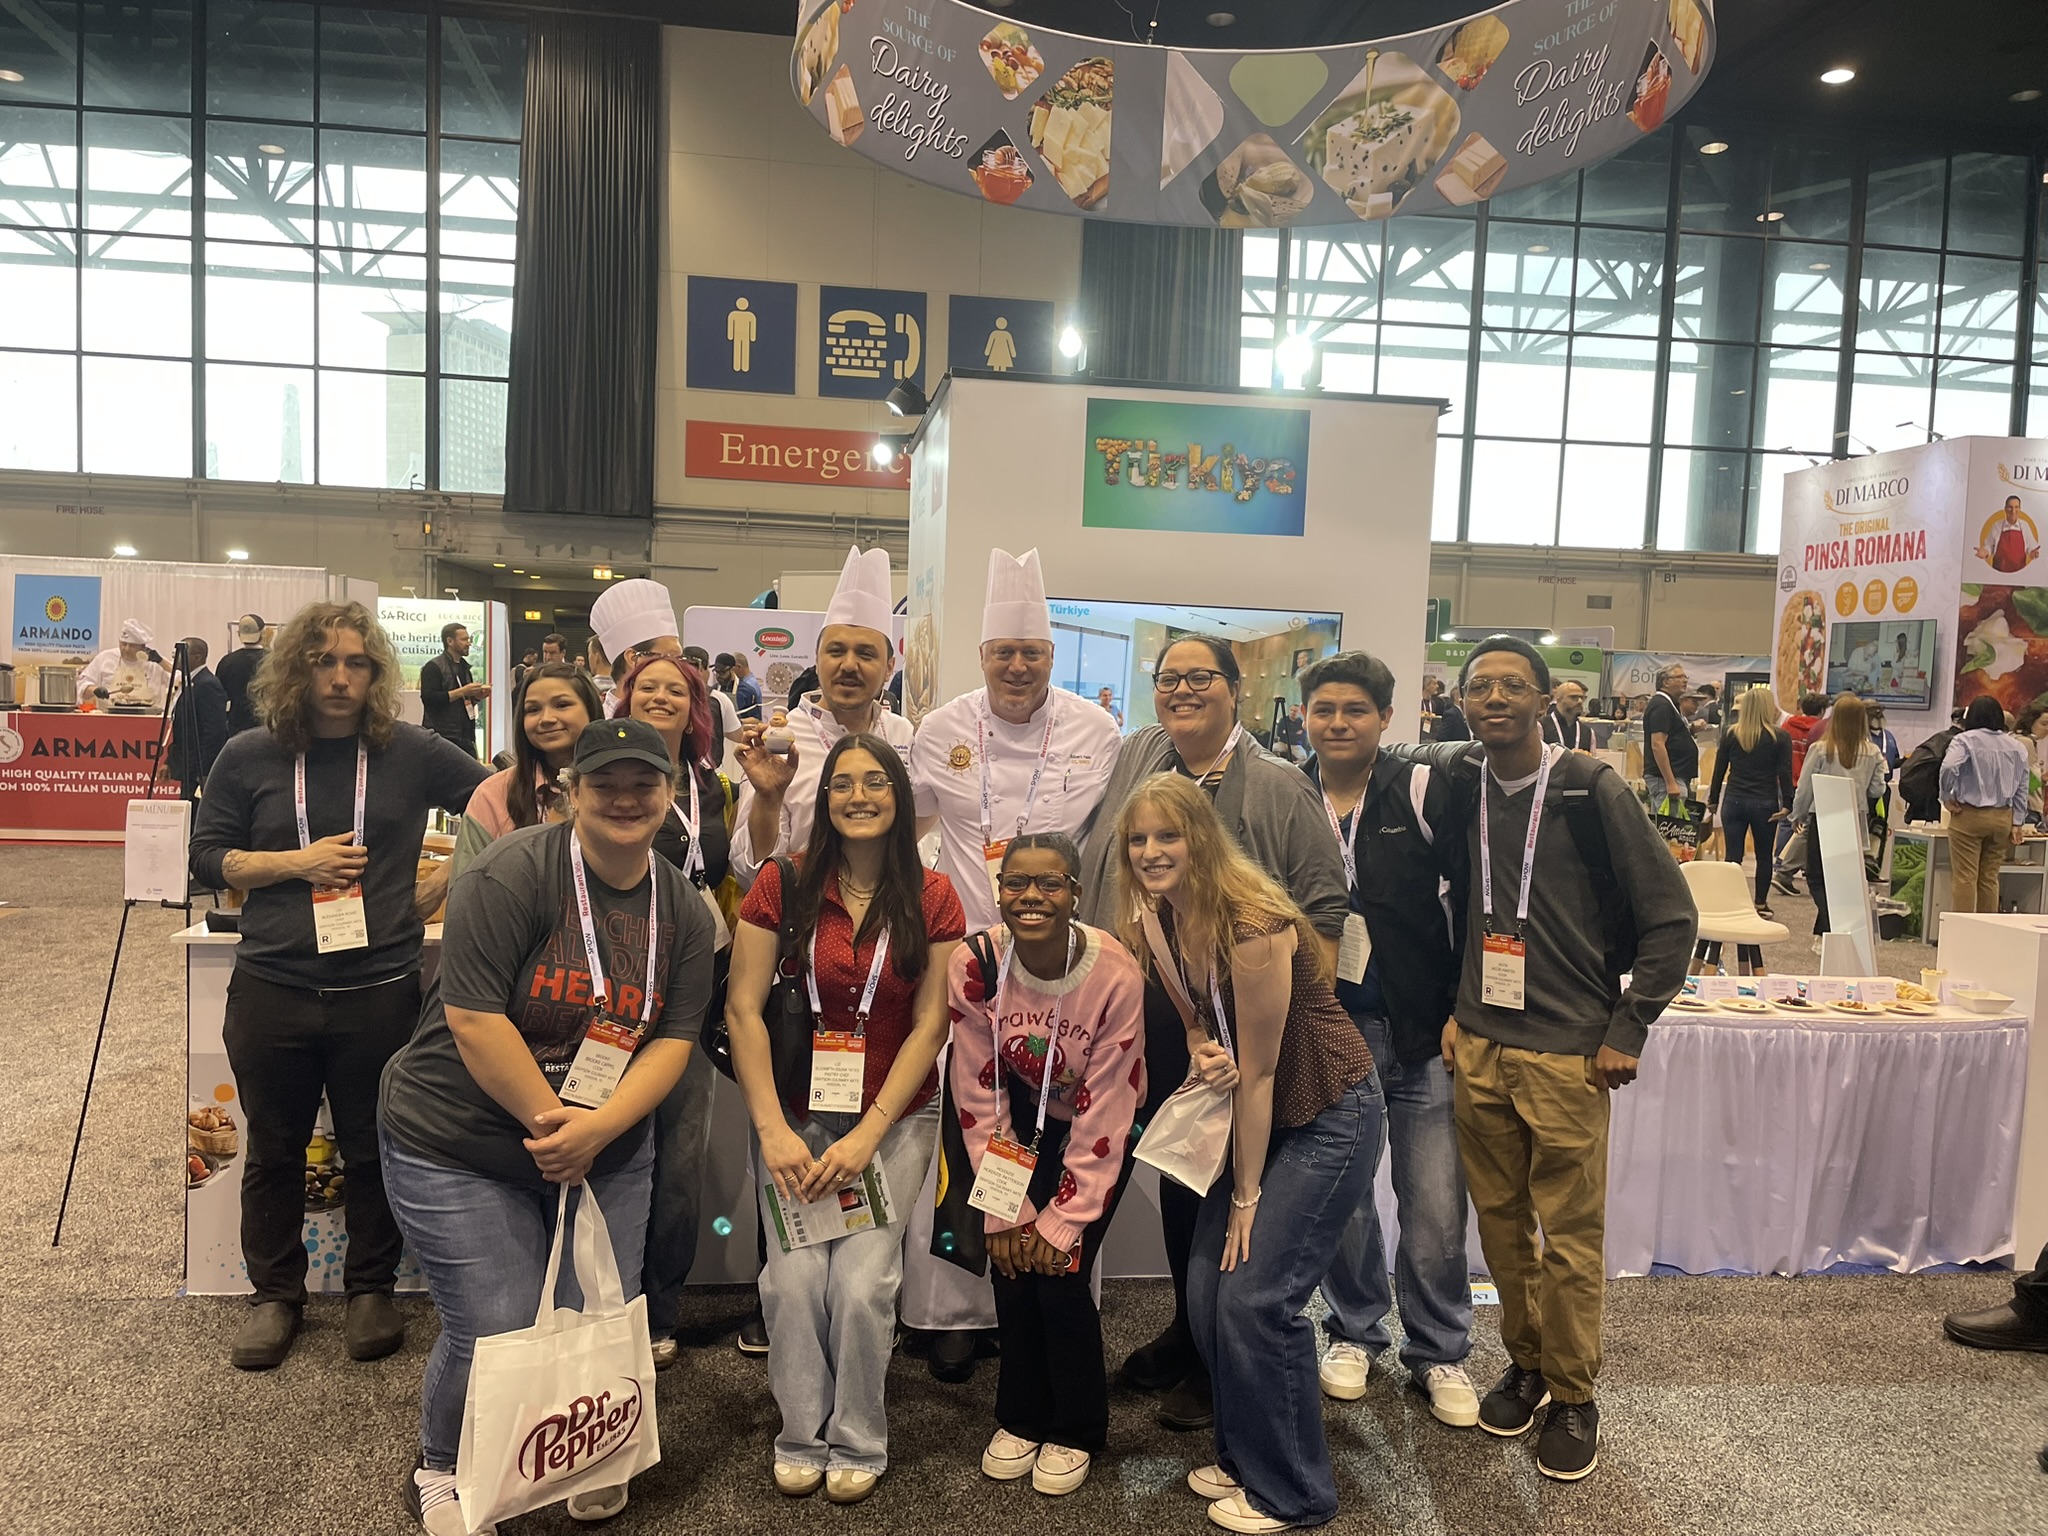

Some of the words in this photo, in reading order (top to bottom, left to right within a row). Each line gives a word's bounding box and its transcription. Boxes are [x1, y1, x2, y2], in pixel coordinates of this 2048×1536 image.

[905, 5, 931, 31] THE
[1565, 0, 1597, 18] THE
[1533, 14, 1596, 56] SOURCE
[1599, 3, 1620, 22] OF
[882, 17, 934, 55] SOURCE
[938, 44, 957, 63] OF
[869, 35, 952, 119] Dairy
[1513, 43, 1611, 107] Dairy
[870, 92, 969, 161] delights
[1516, 79, 1625, 158] delights
[719, 432, 911, 483] Emergenc
[1095, 437, 1296, 502] Türkiye
[2013, 464, 2029, 480] DI
[1835, 488, 1851, 506] DI
[1852, 477, 1909, 502] MARCO
[56, 506, 78, 514] FIRE
[80, 506, 105, 515] HOSE
[1839, 522, 1854, 536] THE
[1854, 517, 1890, 534] ORIGINAL
[1804, 543, 1850, 572] PINSA
[1854, 530, 1927, 566] ROMANA
[1538, 575, 1555, 584] FIRE
[1557, 576, 1577, 585] HOSE
[1664, 574, 1678, 584] B1
[1050, 604, 1090, 618] Türkiye
[20, 626, 92, 641] ARMANDO
[387, 632, 406, 642] he
[2, 769, 32, 778] HIGH
[34, 770, 85, 781] QUALITY
[88, 771, 130, 781] ITALIAN
[20, 782, 50, 792] 100%
[54, 784, 98, 793] ITALIAN
[102, 784, 144, 794] DURUM
[144, 805, 170, 814] MENU
[1381, 826, 1407, 834] Columbia
[1522, 862, 1530, 882] SHOW
[574, 860, 590, 917] Restaurant365
[585, 932, 594, 955] SHOW
[1486, 986, 1492, 994] R
[568, 1080, 577, 1090] R
[814, 1091, 822, 1100] R
[975, 1190, 983, 1198] R
[568, 1390, 611, 1433] Dr
[532, 1395, 637, 1483] Pepper
